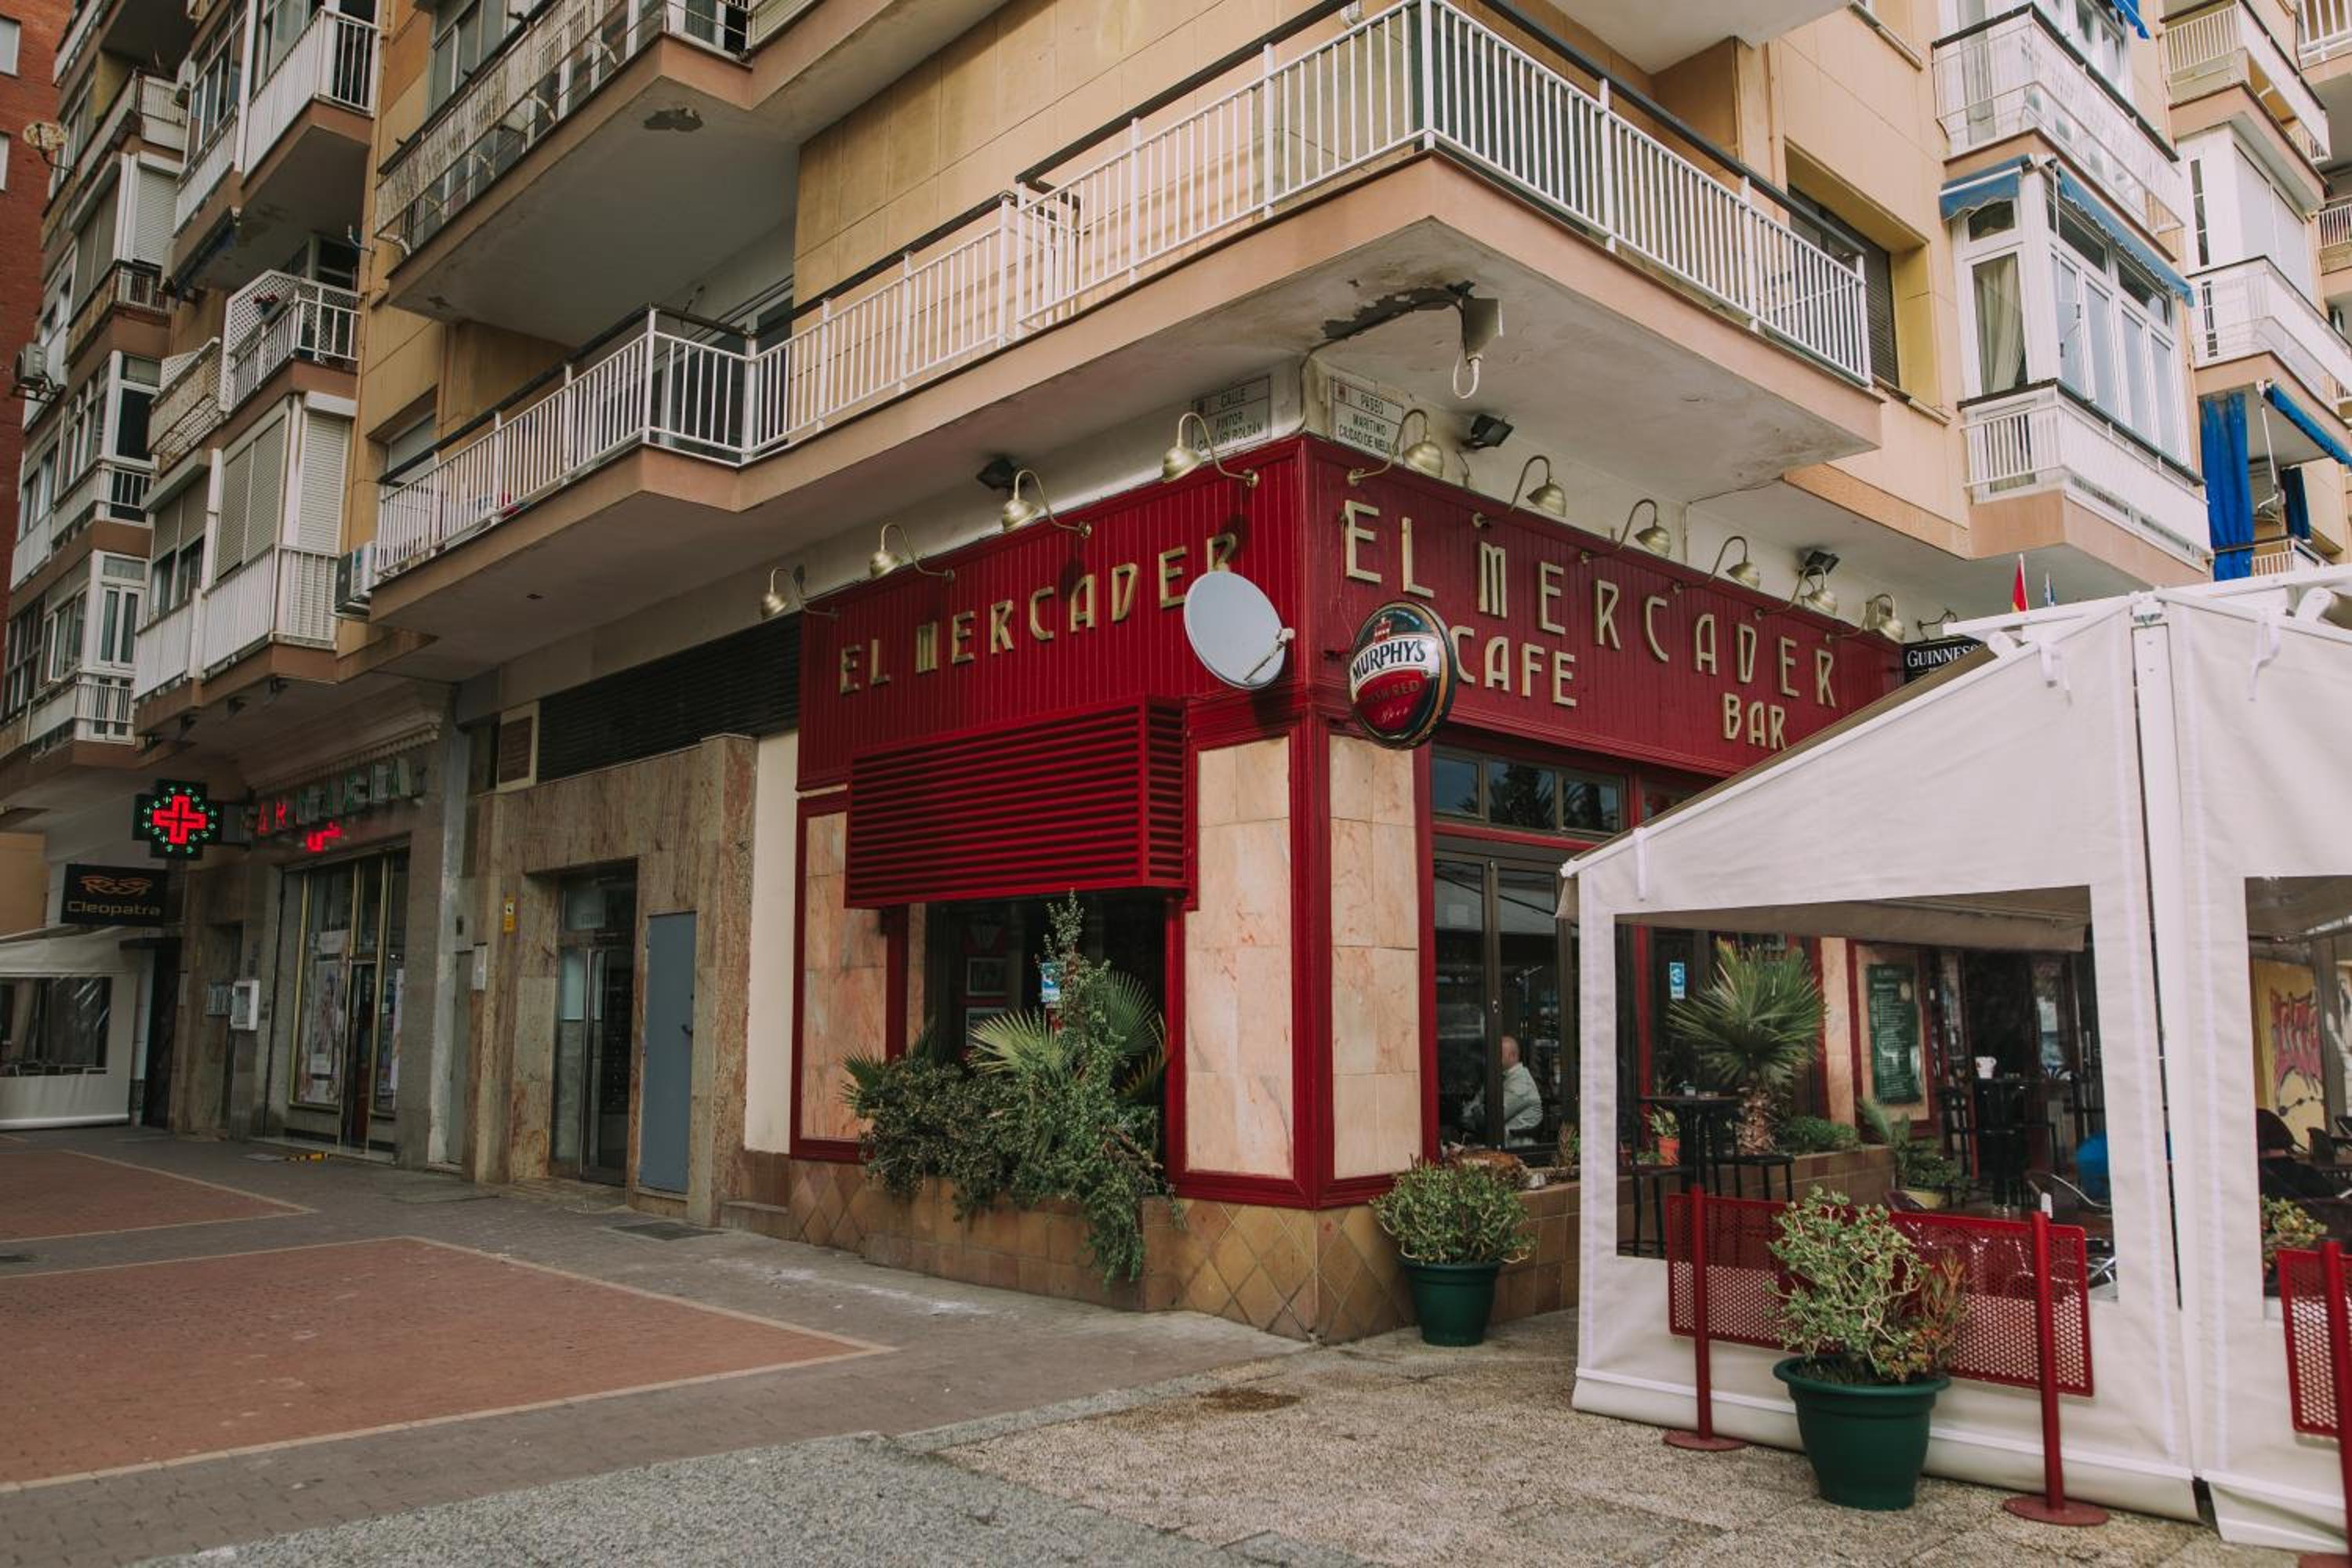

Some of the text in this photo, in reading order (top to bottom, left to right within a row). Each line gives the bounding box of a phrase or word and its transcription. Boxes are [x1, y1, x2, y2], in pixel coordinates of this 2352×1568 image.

[1361, 394, 1384, 414] PASEO
[840, 532, 1237, 695] EL MERCADER
[1345, 499, 1836, 706] EL MERCADER
[1450, 626, 1577, 706] CAFE
[1722, 692, 1787, 750] BAR
[67, 901, 161, 916] Cleopatra
